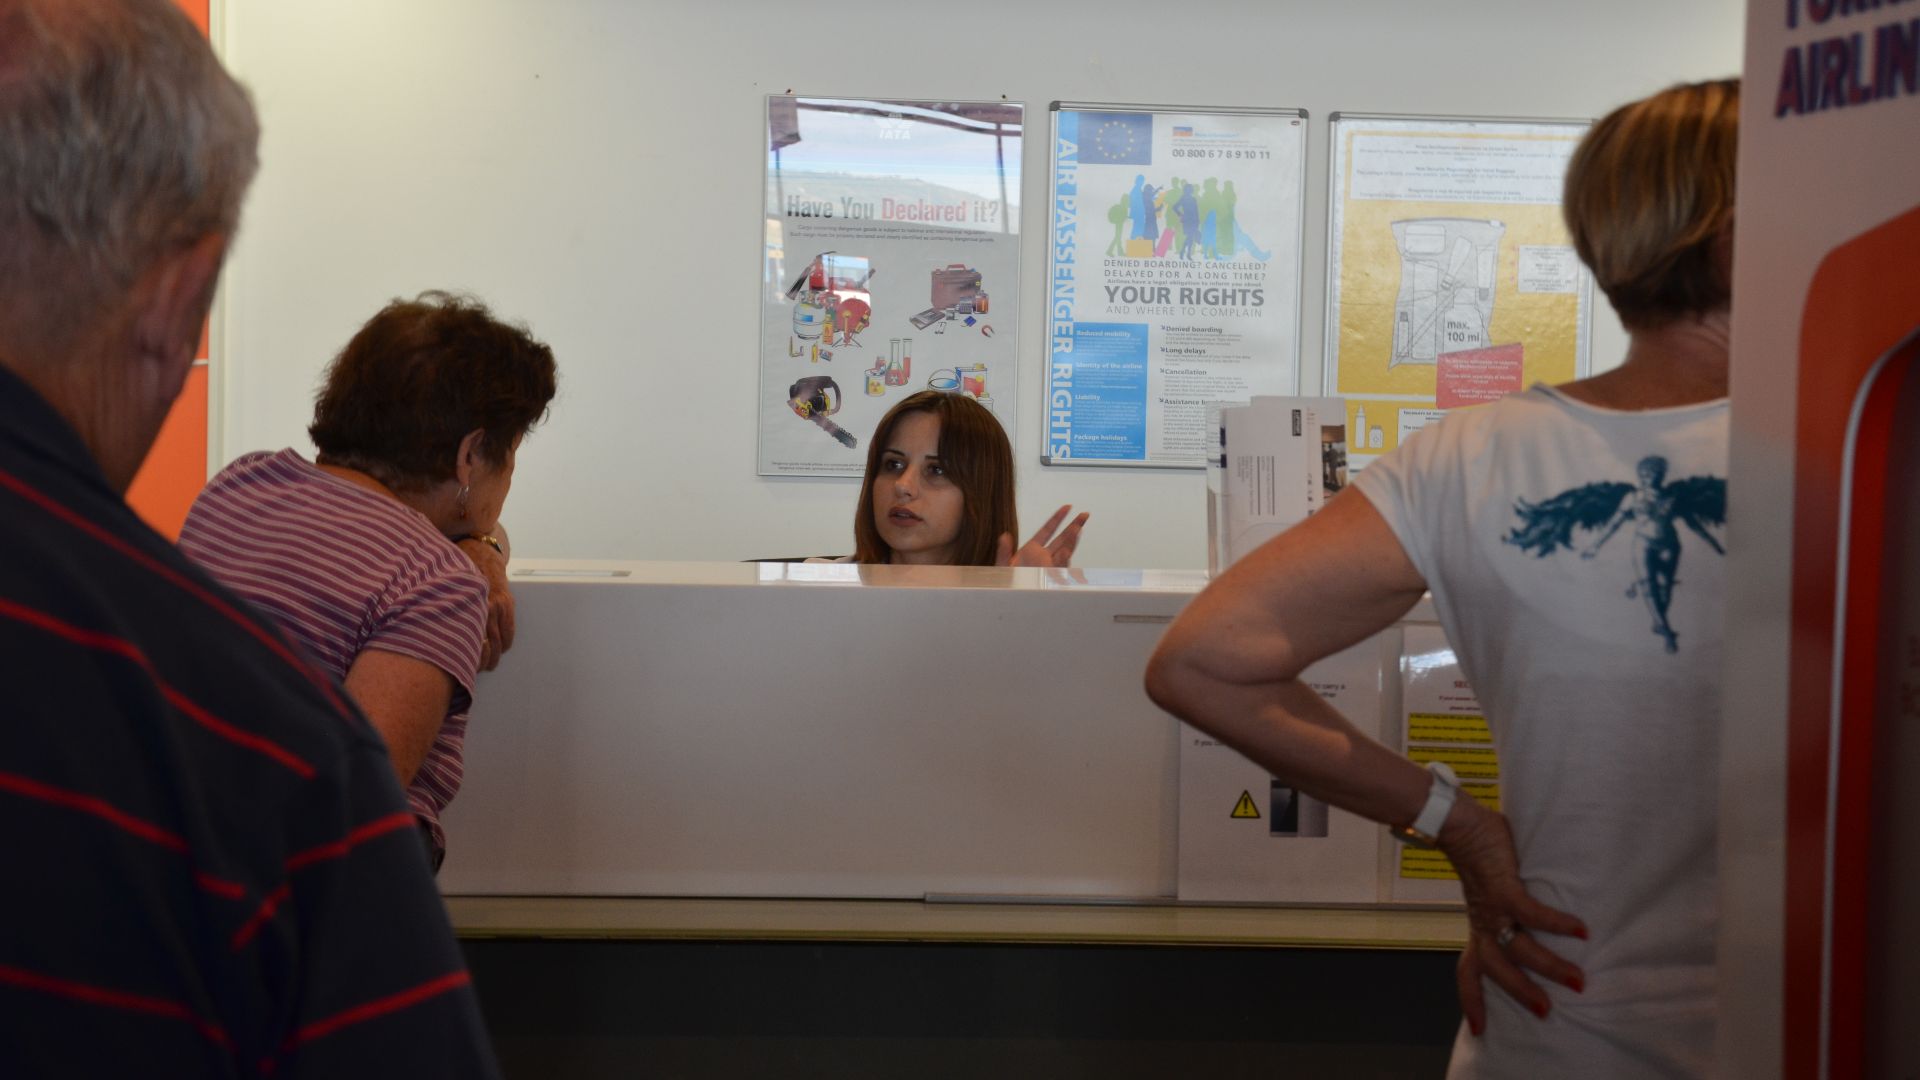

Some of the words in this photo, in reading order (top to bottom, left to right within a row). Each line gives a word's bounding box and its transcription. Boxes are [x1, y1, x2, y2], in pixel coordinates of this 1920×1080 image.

[879, 128, 912, 141] IATA
[1172, 148, 1185, 158] 00
[1187, 149, 1206, 159] 800
[1217, 149, 1225, 159] 7
[1226, 150, 1234, 160] 8
[1235, 150, 1243, 160] 9
[1245, 150, 1257, 160] 10
[1259, 150, 1271, 161] 11
[1057, 138, 1079, 186] AIR
[787, 194, 834, 218] Have
[840, 196, 875, 220] You
[881, 197, 967, 222] Declared
[974, 200, 1000, 224] it?
[1104, 258, 1140, 269] DENIED
[1144, 258, 1201, 270] BOARDING?
[1205, 260, 1267, 272] CANCELLED?
[1054, 193, 1078, 355] PASSENGER
[1104, 269, 1154, 279] DELAYED
[1159, 270, 1181, 280] FOR
[1185, 270, 1196, 280] A
[1198, 270, 1229, 280] LONG
[1233, 271, 1267, 282] TIME?
[1153, 279, 1168, 288] legal
[1169, 280, 1201, 288] obligation
[1104, 285, 1172, 306] YOUR
[1179, 287, 1266, 308] RIGHTS
[1106, 305, 1131, 316] AND
[1136, 305, 1176, 318] WHERE
[1181, 307, 1197, 317] TO
[1201, 307, 1263, 319] COMPLAIN
[1166, 325, 1191, 334] Denied
[1192, 325, 1223, 335] boarding
[1446, 320, 1471, 331] max.
[1105, 330, 1131, 338] mobility
[1447, 332, 1466, 343] 100
[1467, 332, 1481, 343] ml
[1165, 347, 1183, 356] Long
[1184, 347, 1206, 356] delays
[1110, 362, 1122, 370] the
[1164, 368, 1207, 376] Cancellation
[1075, 394, 1102, 404] Liability
[1164, 397, 1201, 406] Assistance
[1051, 362, 1074, 460] RIGHTS
[1074, 433, 1100, 444] Package
[1100, 434, 1128, 444] holidays
